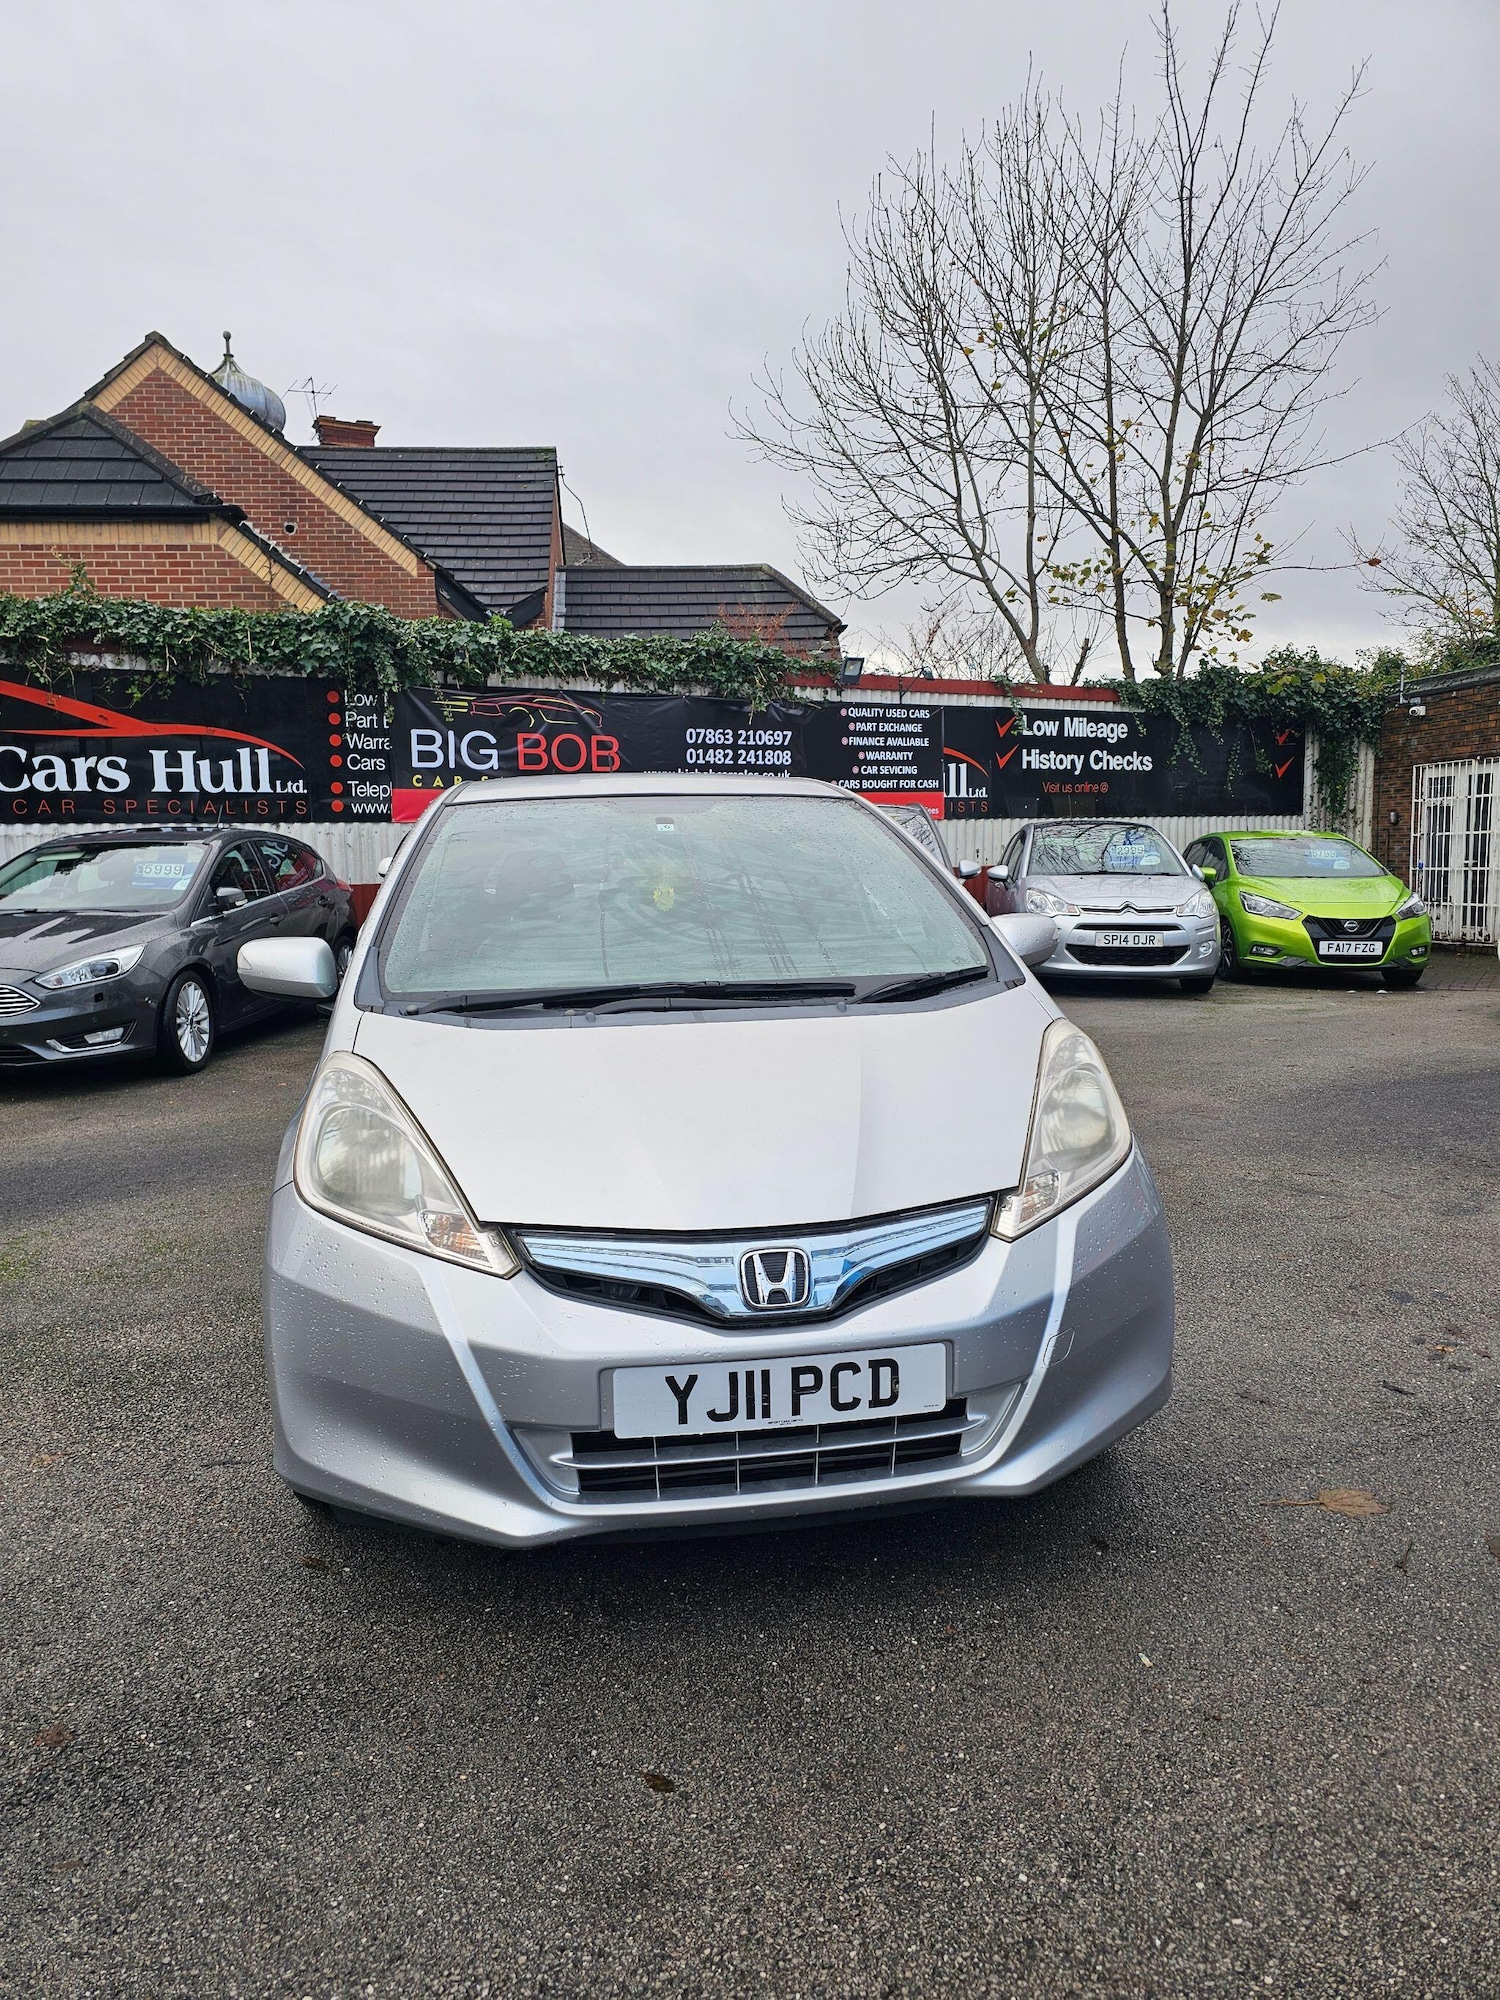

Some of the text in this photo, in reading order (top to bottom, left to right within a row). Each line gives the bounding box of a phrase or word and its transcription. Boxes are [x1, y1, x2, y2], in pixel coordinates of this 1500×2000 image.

[345, 711, 378, 729] Part
[848, 707, 930, 719] QUALITY USED CARS
[856, 722, 923, 733] PART EXCHANGE
[1022, 715, 1128, 743] Low Mileage
[686, 728, 793, 746] 07863 210697
[849, 736, 930, 747] FINANCE AVALIABLE
[410, 728, 621, 772] BIG BOB
[686, 748, 792, 765] 01482 241808
[866, 751, 913, 761] WARRANTY
[346, 753, 386, 771] Cars
[1022, 749, 1153, 775] History Checks
[0, 745, 307, 794] Cars Hull Ltd.
[861, 764, 918, 775] CAR SEVICING
[838, 778, 939, 790] CARS BOUGHT FOR CASH
[1042, 781, 1060, 793] Visit
[1062, 783, 1073, 793] us
[968, 787, 988, 798] Ltd.
[12, 799, 308, 815] CAR SPECIALISTS
[1103, 934, 1156, 945] SP14 OJR
[1327, 943, 1375, 953] FA17 FZG
[665, 1358, 899, 1424] YJ11 PCD
